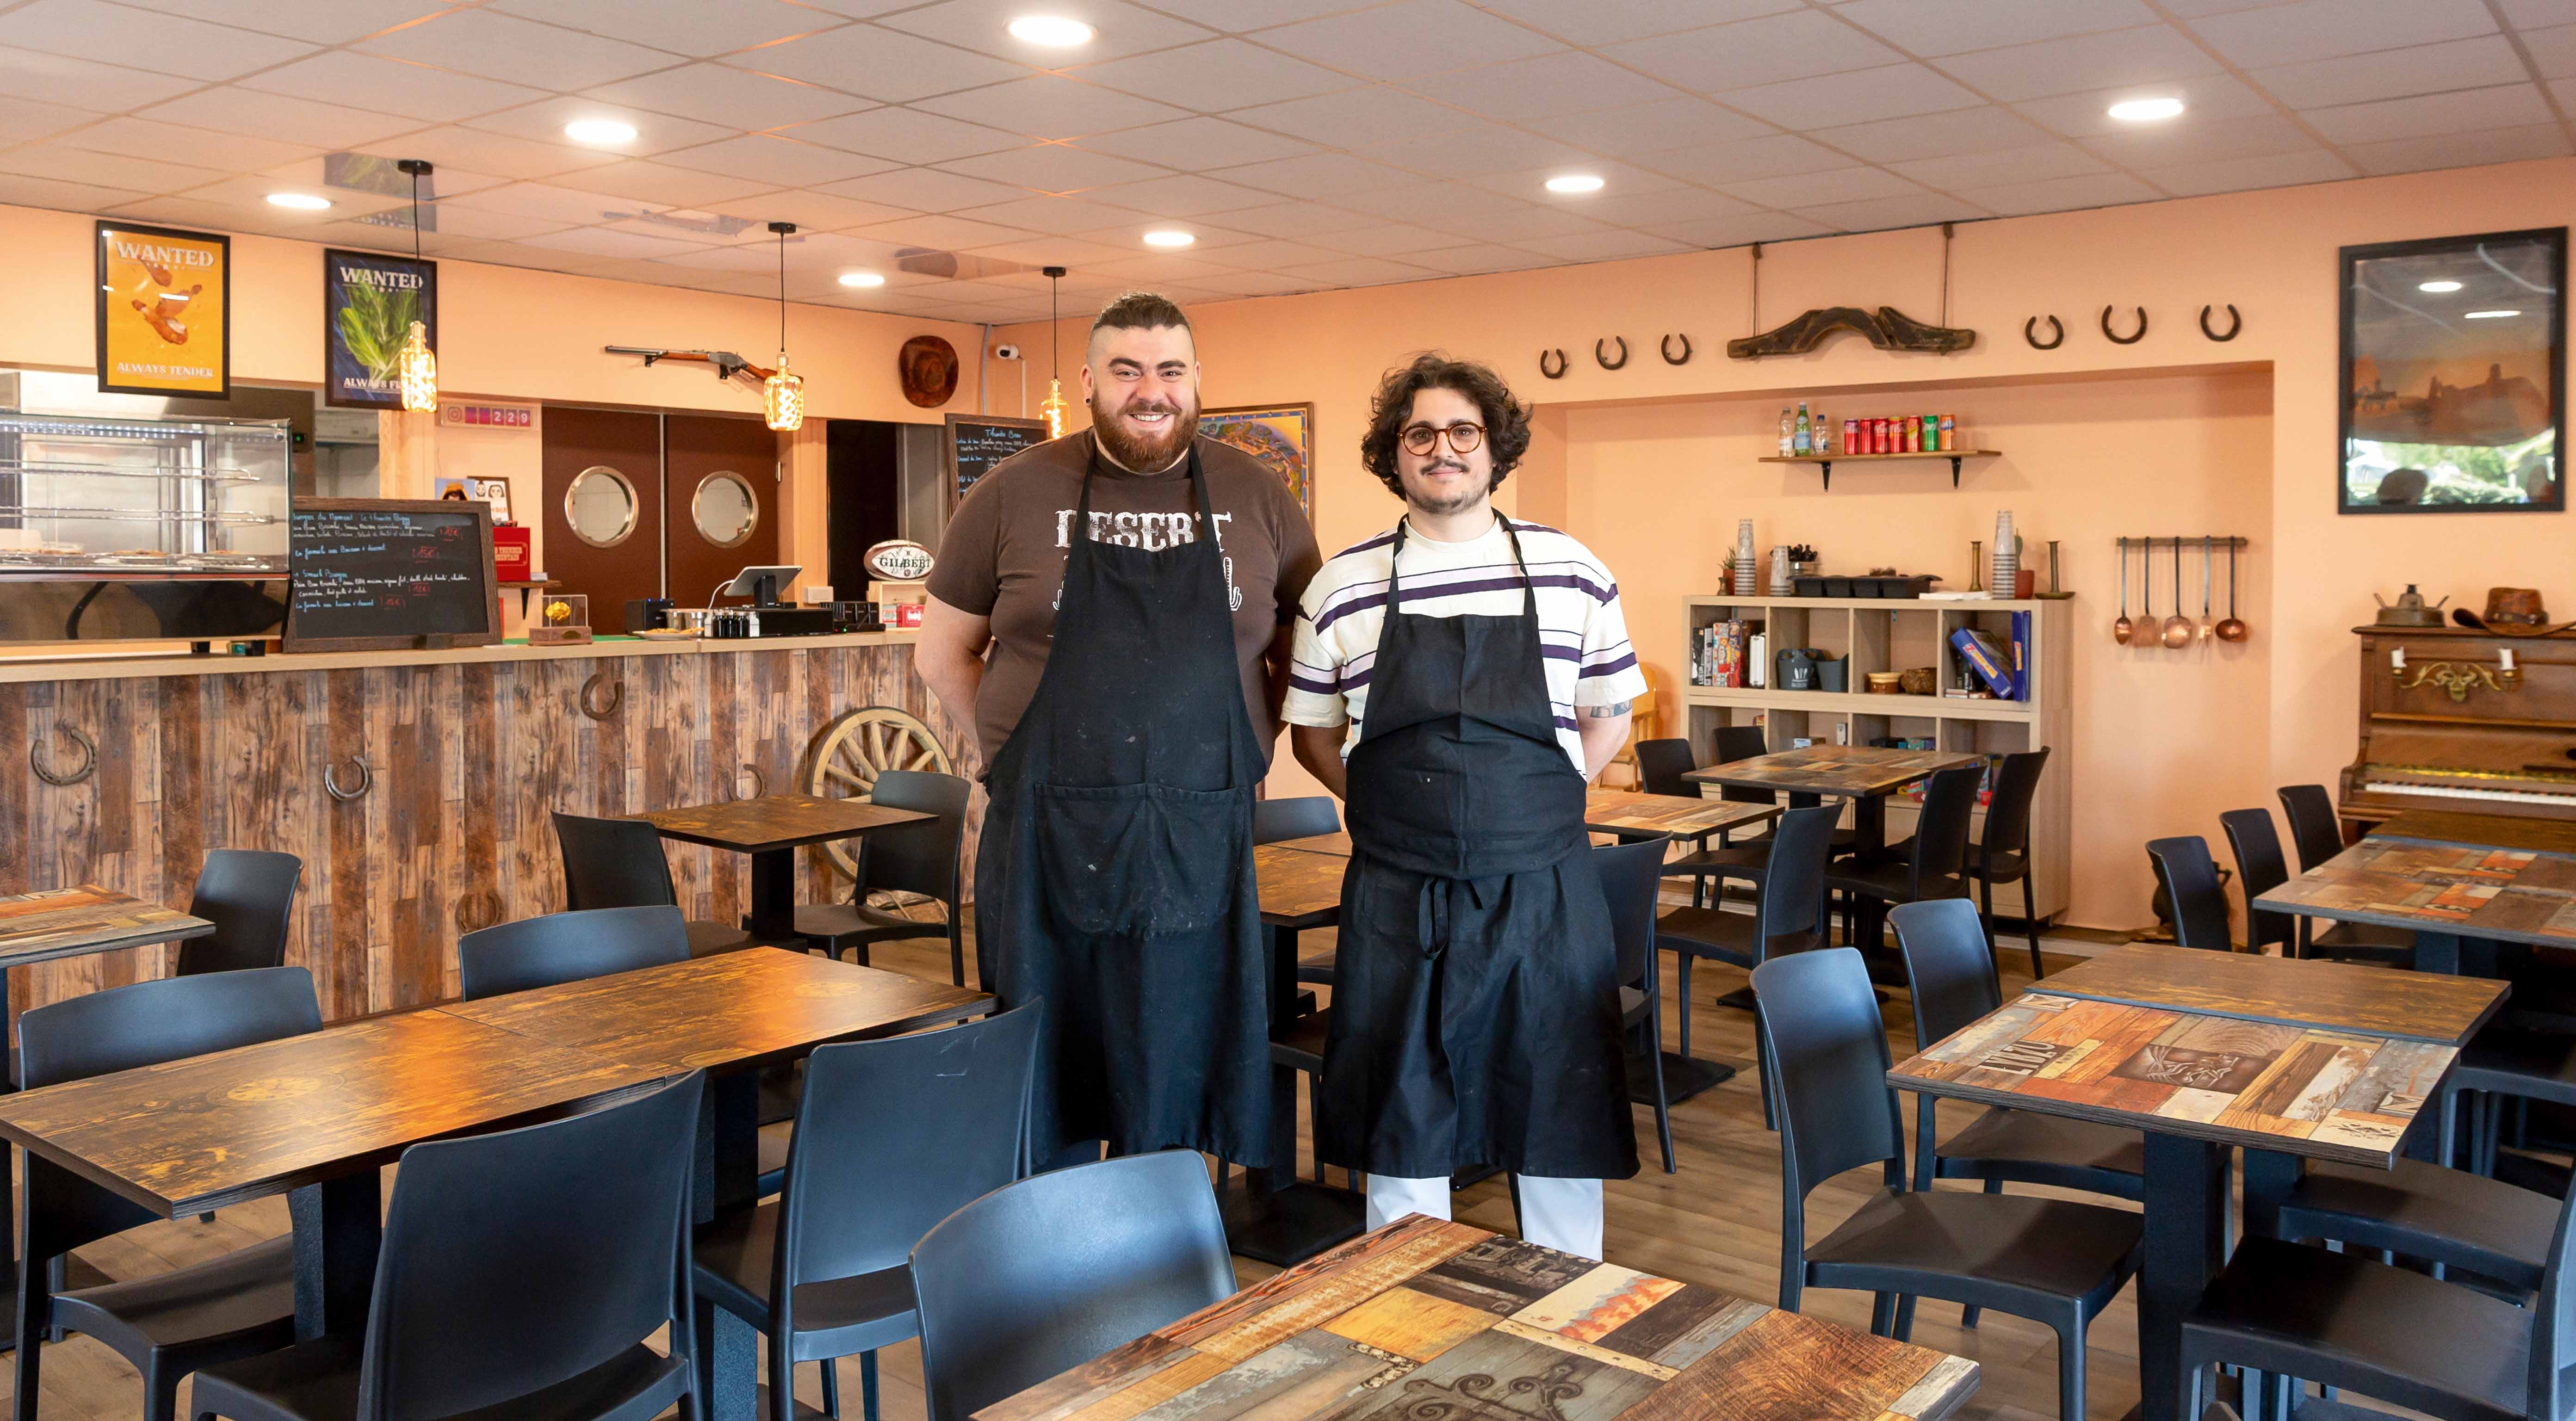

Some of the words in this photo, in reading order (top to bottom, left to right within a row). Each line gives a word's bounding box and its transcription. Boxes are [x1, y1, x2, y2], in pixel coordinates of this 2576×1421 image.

[116, 241, 215, 267] WANTED
[340, 266, 423, 289] WANTED
[117, 362, 166, 374] ALWAYS
[169, 365, 213, 378] TENDER
[879, 557, 930, 568] GILBERT
